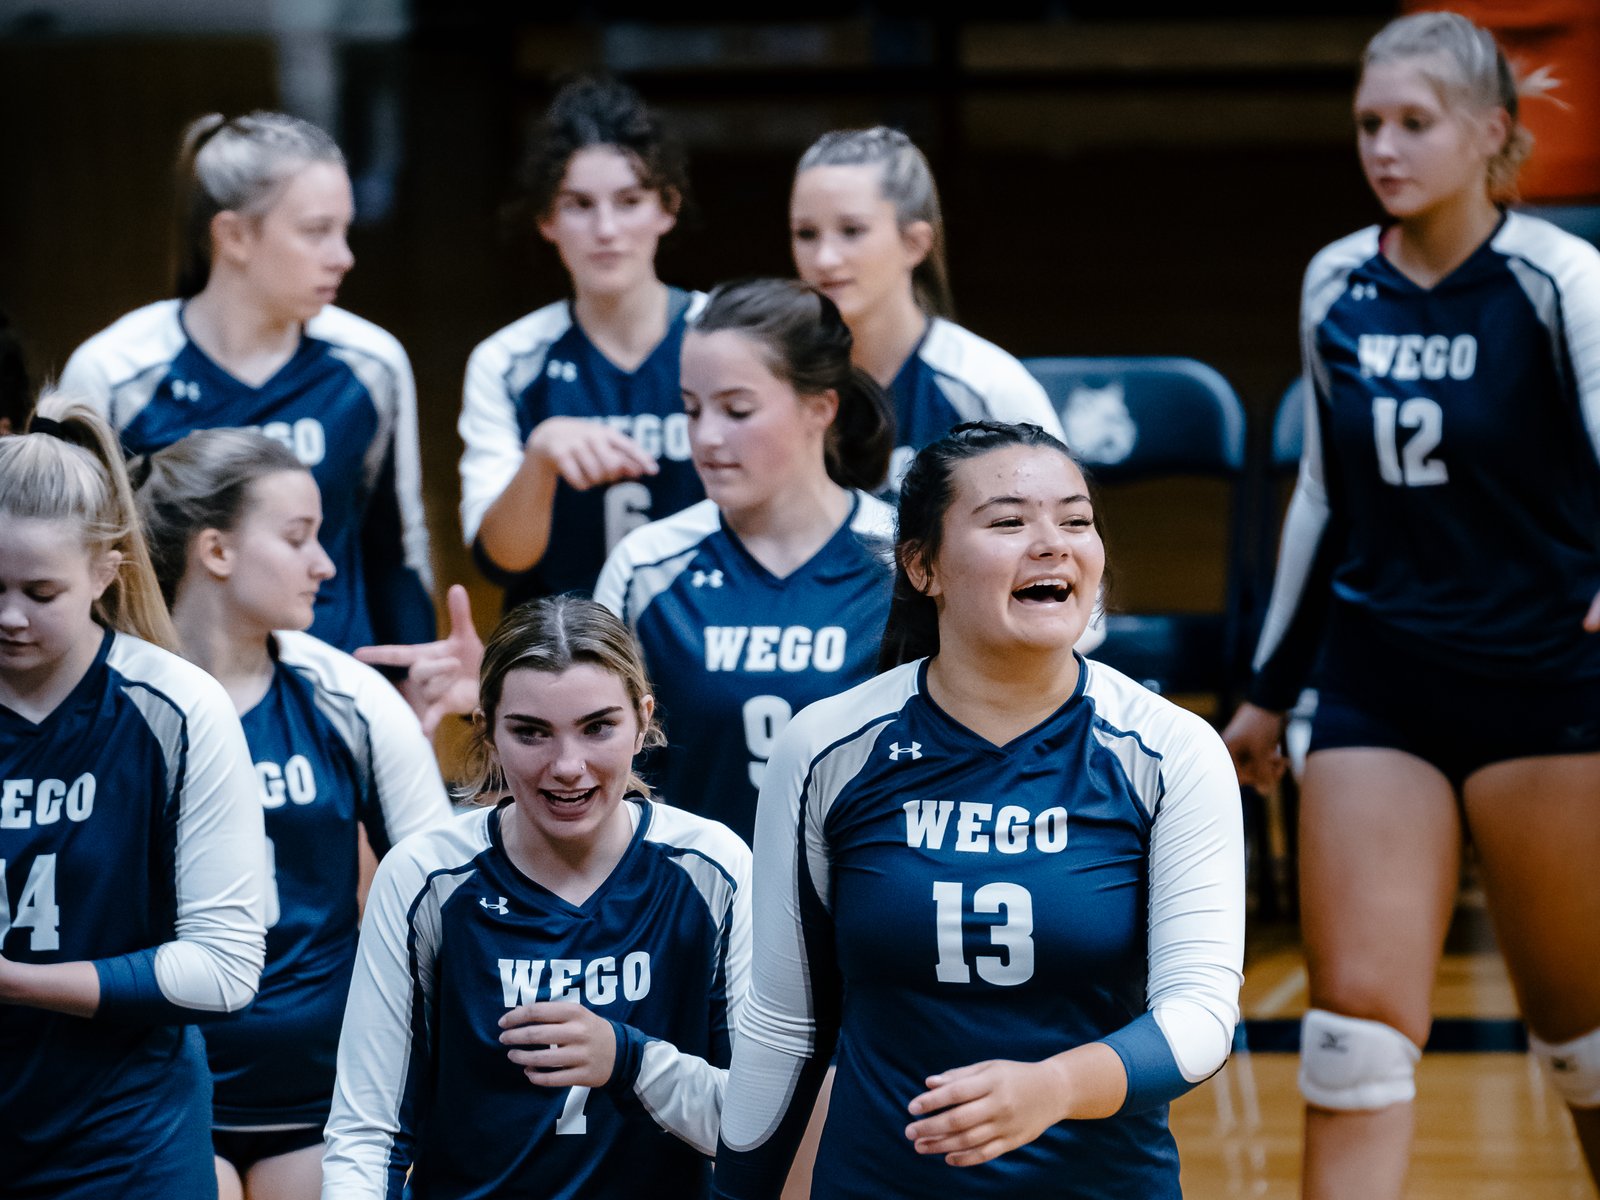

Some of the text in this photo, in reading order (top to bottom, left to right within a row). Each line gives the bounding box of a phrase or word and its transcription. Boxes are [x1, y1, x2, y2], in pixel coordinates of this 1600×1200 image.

[1358, 333, 1477, 380] WEGO
[1372, 397, 1449, 487] 12
[704, 625, 847, 672] WEGO
[0, 772, 96, 829] EGO
[903, 800, 1068, 854] WEGO
[933, 881, 1034, 986] 13
[498, 951, 651, 1008] WEGO
